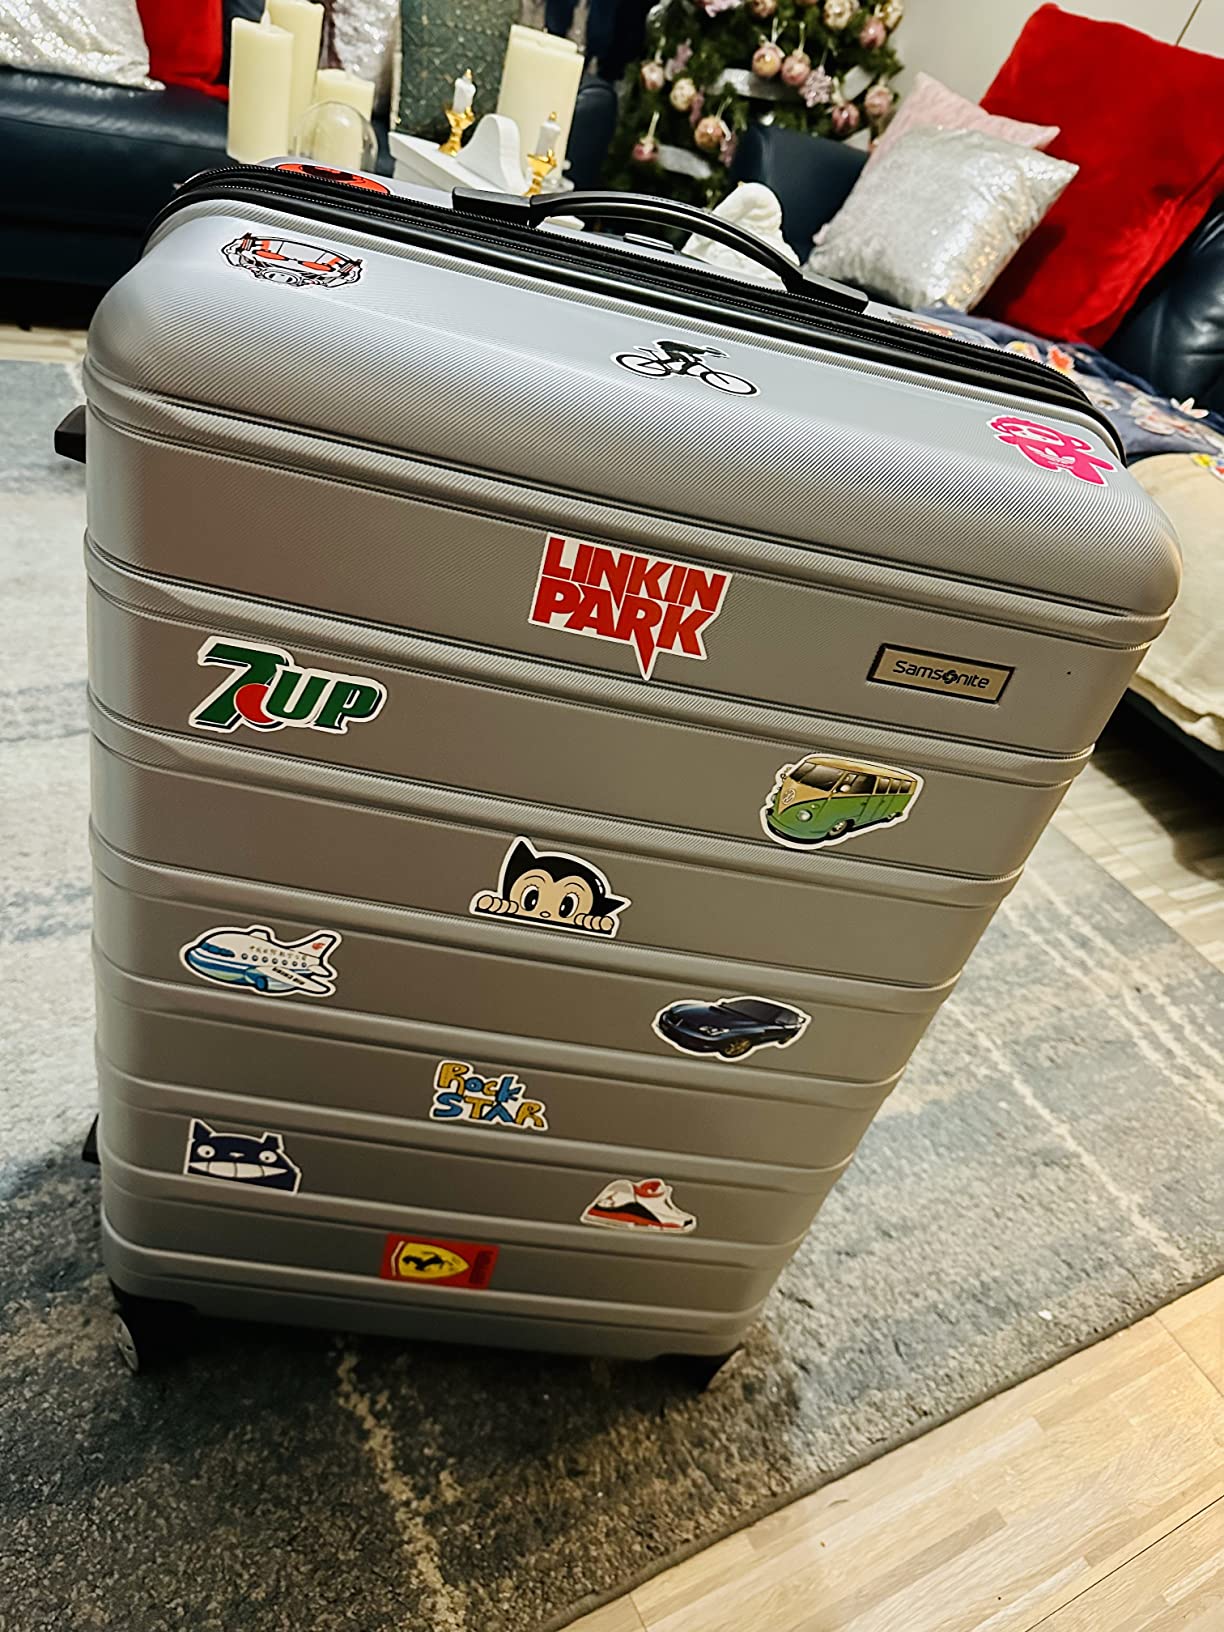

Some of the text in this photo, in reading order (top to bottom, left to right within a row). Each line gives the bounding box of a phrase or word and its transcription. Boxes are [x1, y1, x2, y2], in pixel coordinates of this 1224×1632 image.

[542, 536, 728, 613] LINKIN
[532, 575, 716, 676] PARK
[194, 642, 382, 730] 7UP
[893, 660, 990, 688] Samsonite
[433, 1092, 545, 1128] STAR
[437, 1062, 522, 1103] Rock
